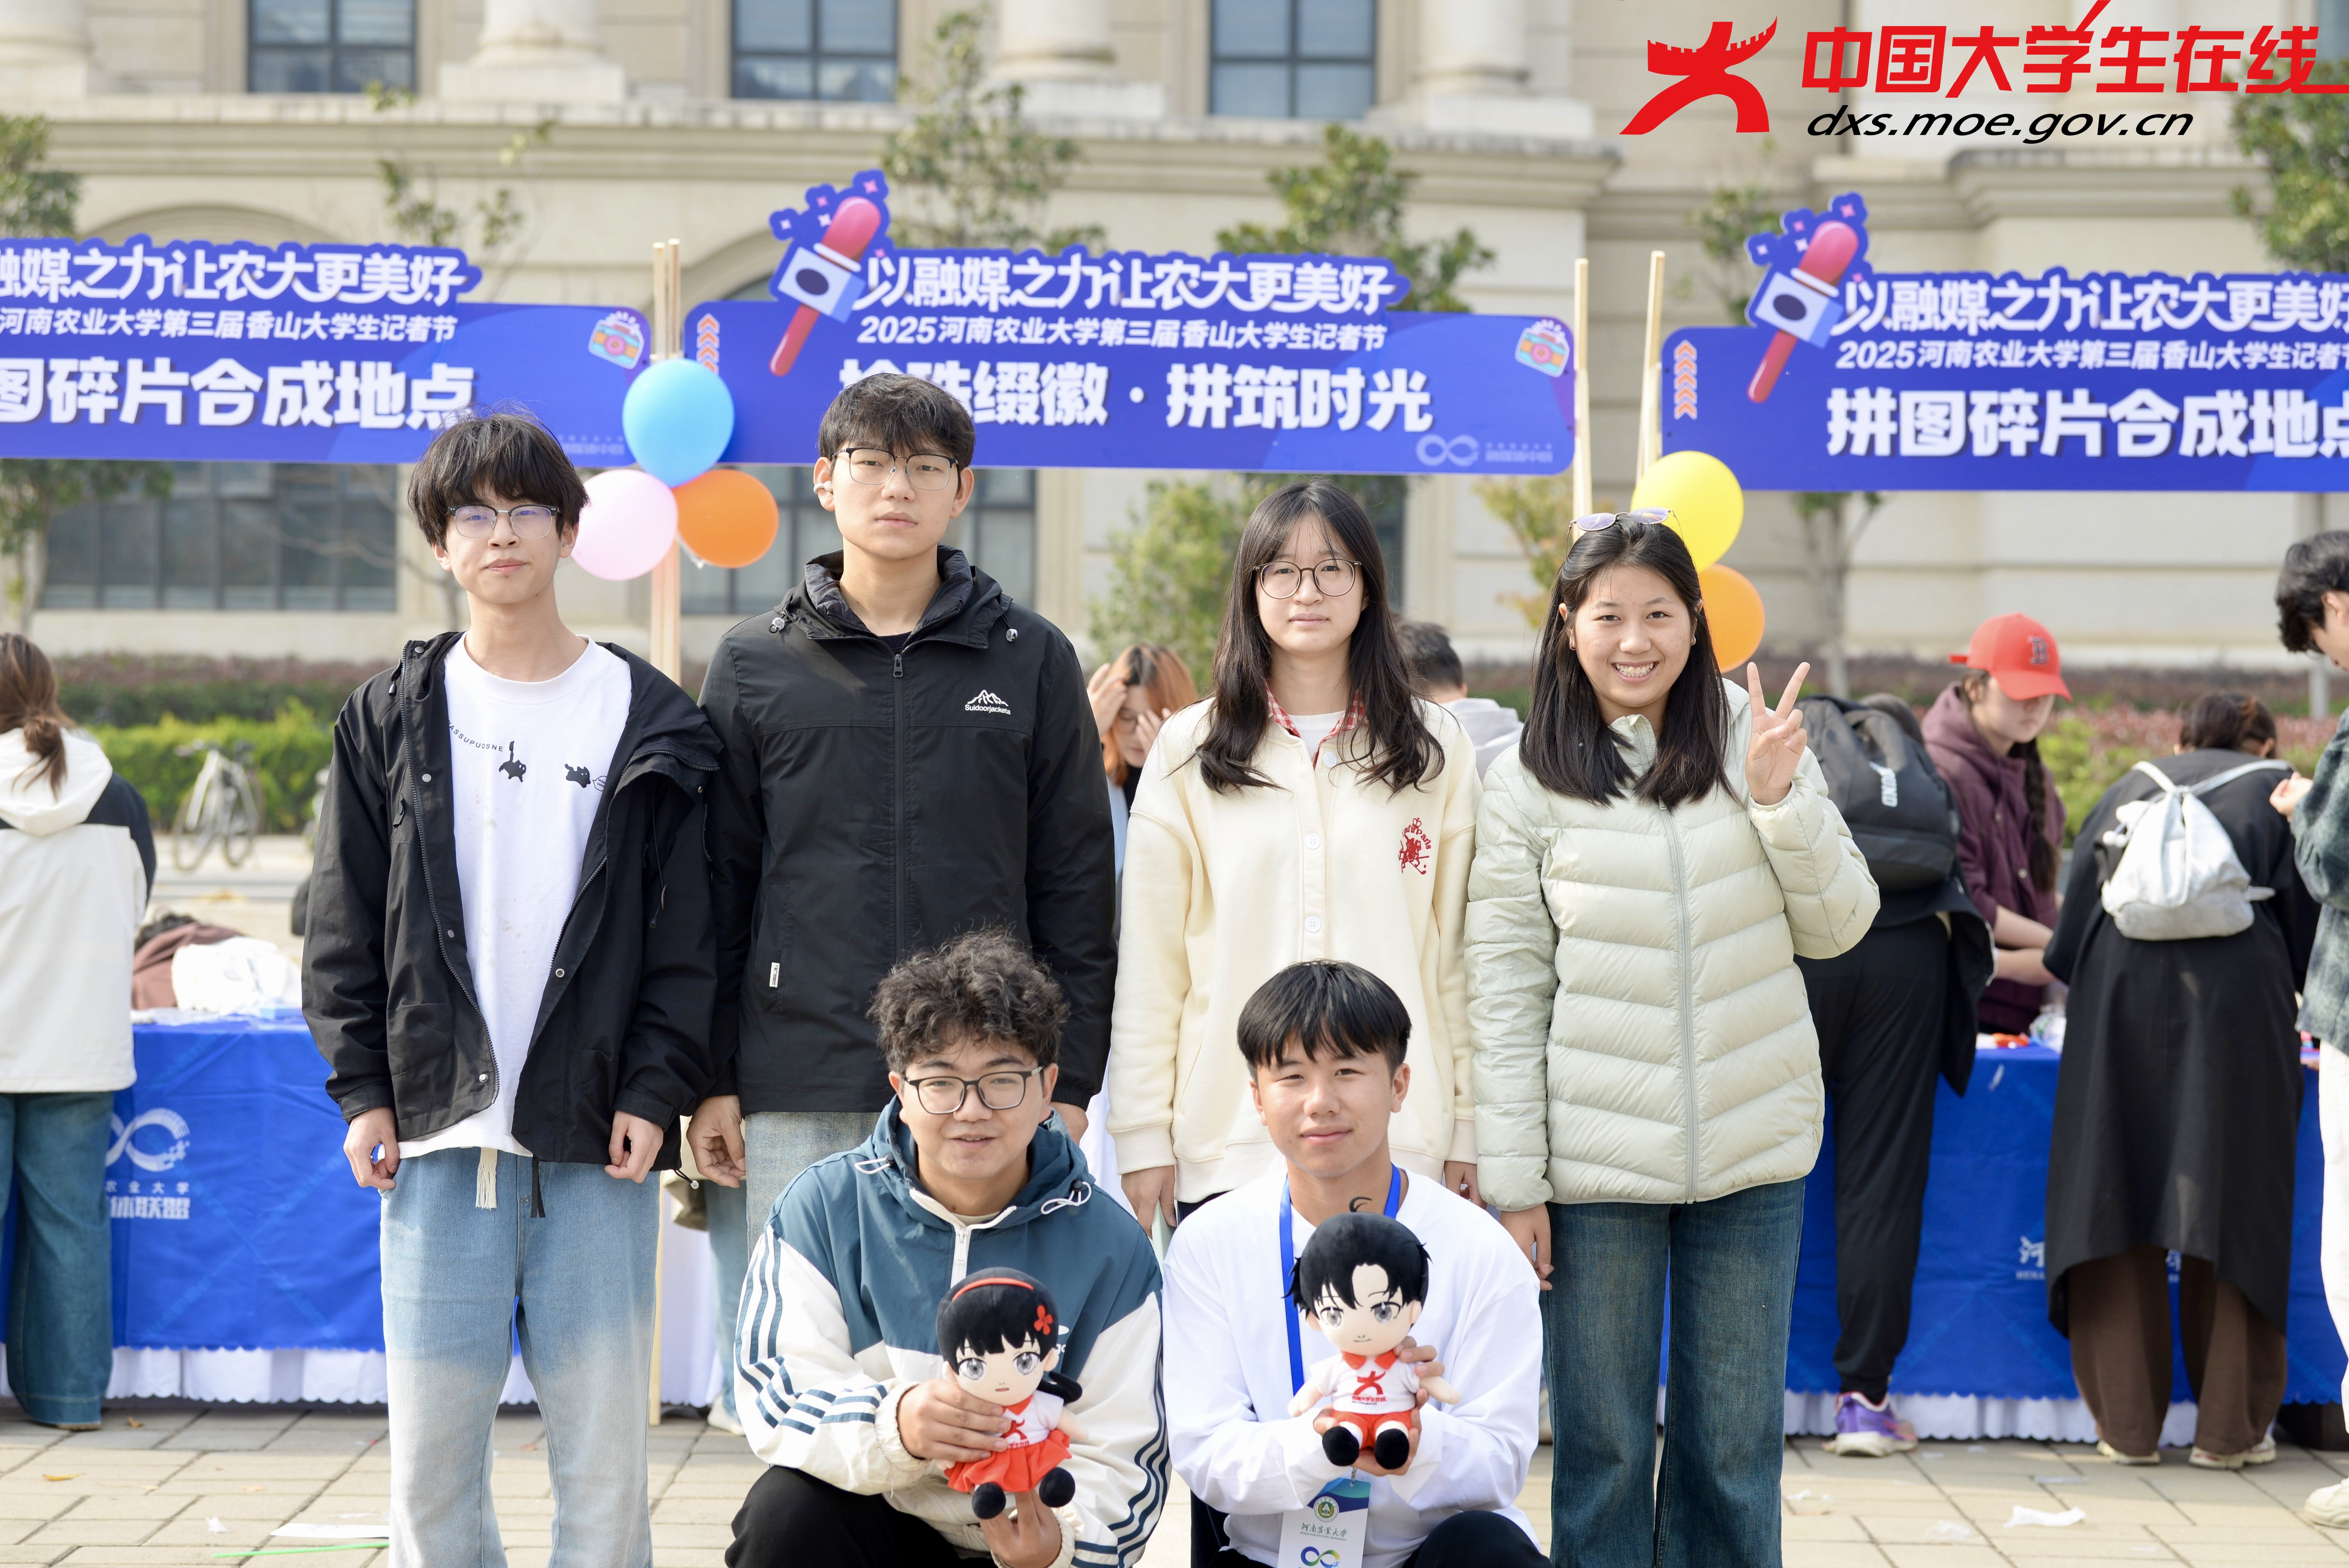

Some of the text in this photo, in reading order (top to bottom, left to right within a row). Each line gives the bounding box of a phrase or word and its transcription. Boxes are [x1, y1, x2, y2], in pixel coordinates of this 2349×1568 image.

[852, 253, 1395, 315] 以融媒之力让农大更美好
